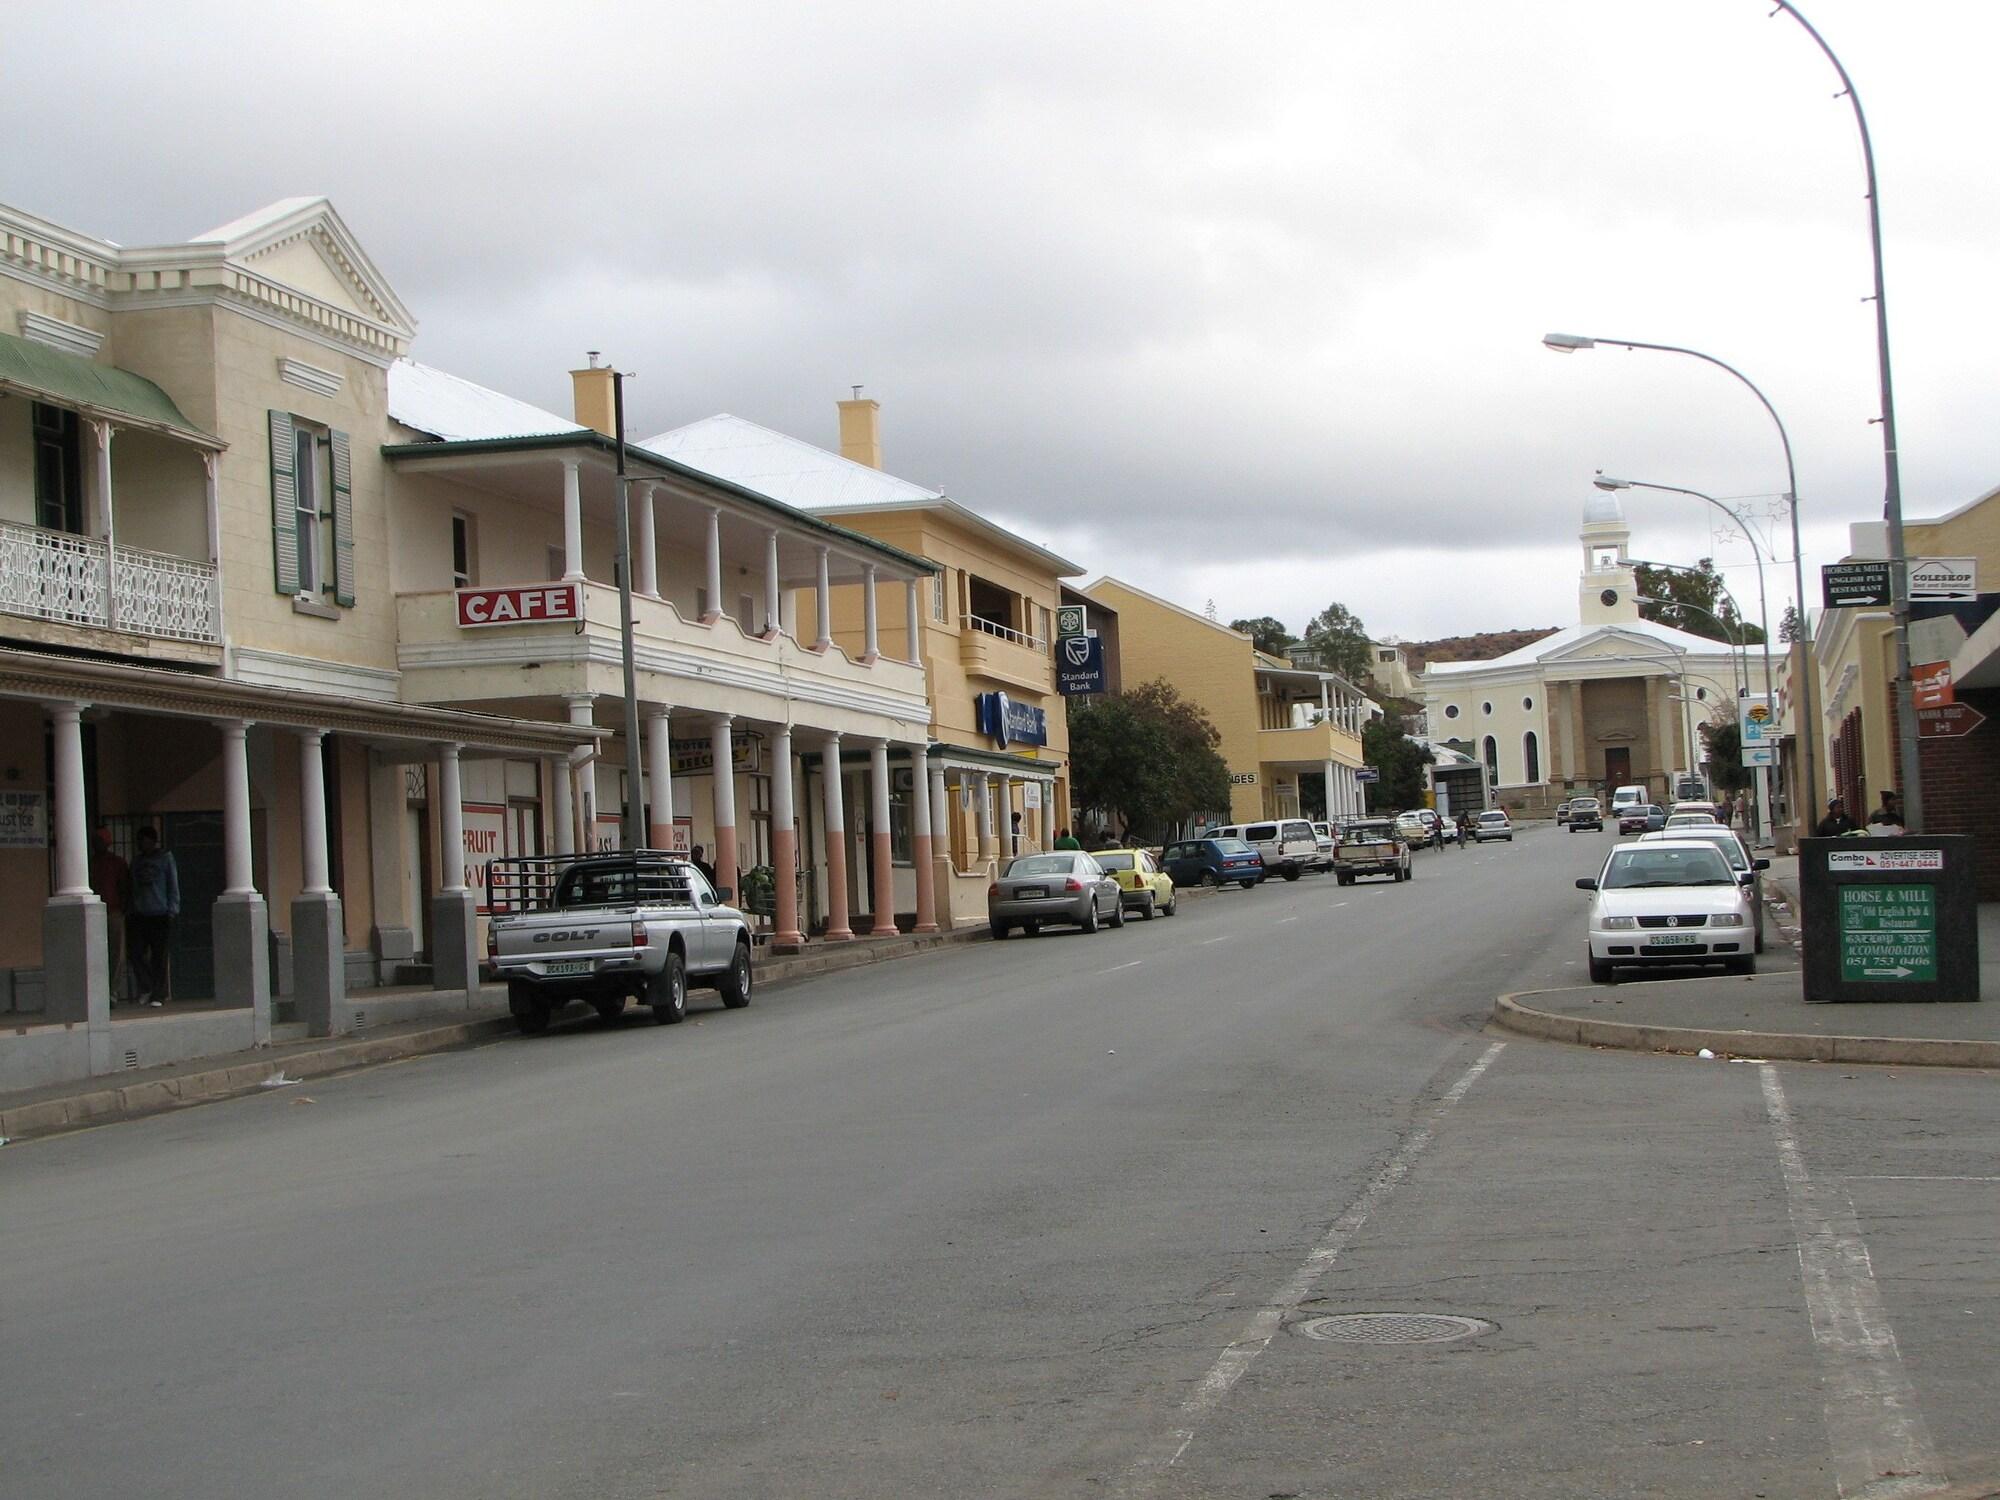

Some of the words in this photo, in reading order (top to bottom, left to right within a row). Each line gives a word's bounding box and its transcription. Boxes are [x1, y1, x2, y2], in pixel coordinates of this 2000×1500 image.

[1824, 565, 1853, 575] HORSE
[1864, 564, 1888, 573] MILL
[1829, 575, 1865, 584] ENGLISH
[1866, 574, 1884, 583] PUB
[1912, 574, 1972, 582] COLESKOP
[1830, 584, 1882, 594] RESTAURANT
[466, 589, 569, 622] CAFE
[1061, 670, 1099, 681] Standard
[1070, 682, 1091, 691] Bank
[1830, 853, 1865, 862] Combo
[1880, 851, 1918, 860] ADVERTISE
[1920, 850, 1939, 860] HERE
[1916, 860, 1938, 868] 0444
[1843, 890, 1882, 903] HORSE
[1886, 890, 1895, 902] &
[1899, 890, 1929, 902] MILL
[1907, 905, 1921, 917] Pub
[532, 929, 600, 943] COLT
[1849, 945, 1929, 956] ACCOMMODATION
[1846, 957, 1867, 966] 051
[1872, 957, 1895, 966] 753
[1899, 957, 1930, 966] 0406
